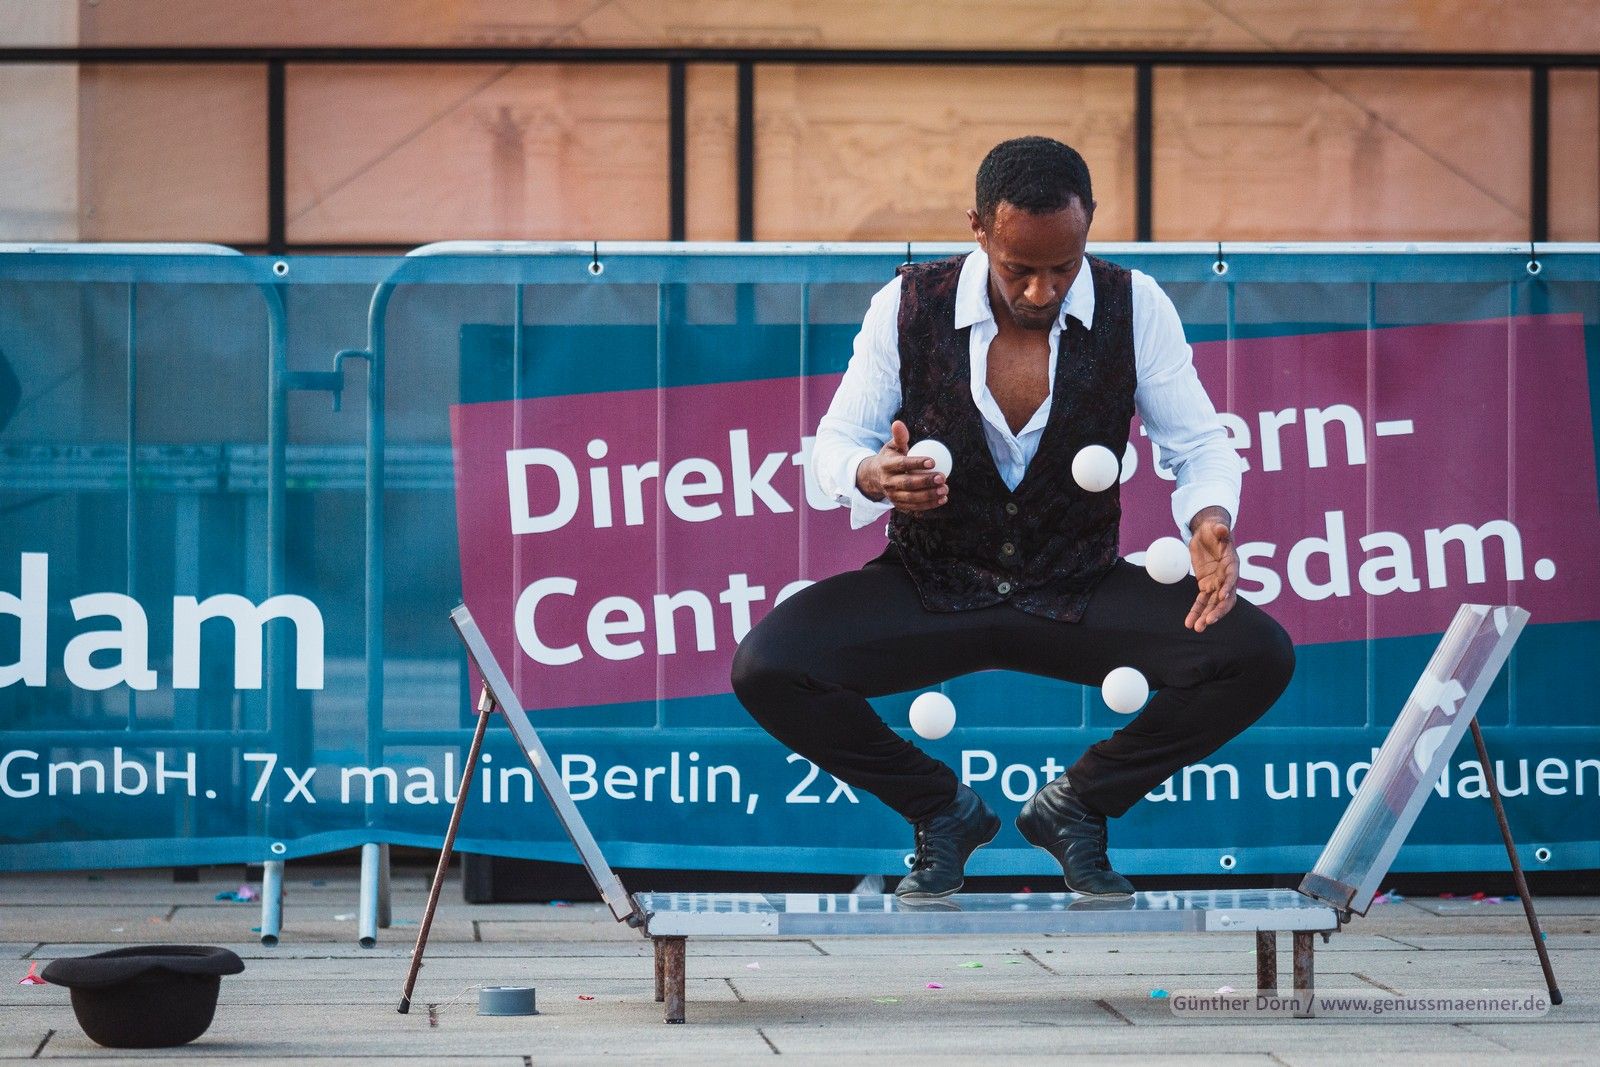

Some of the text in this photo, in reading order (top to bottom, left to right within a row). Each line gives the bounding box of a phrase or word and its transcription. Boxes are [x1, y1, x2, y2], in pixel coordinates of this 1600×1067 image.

[505, 405, 1414, 535] Direkt ern-
[514, 573, 817, 666] Cent
[0, 747, 217, 799] GmbH.
[243, 753, 317, 803] 7x
[340, 752, 460, 804] mal
[482, 753, 534, 803] in
[561, 752, 759, 815] Berlin,
[784, 753, 860, 804] 2x
[1434, 755, 1600, 799] auen
